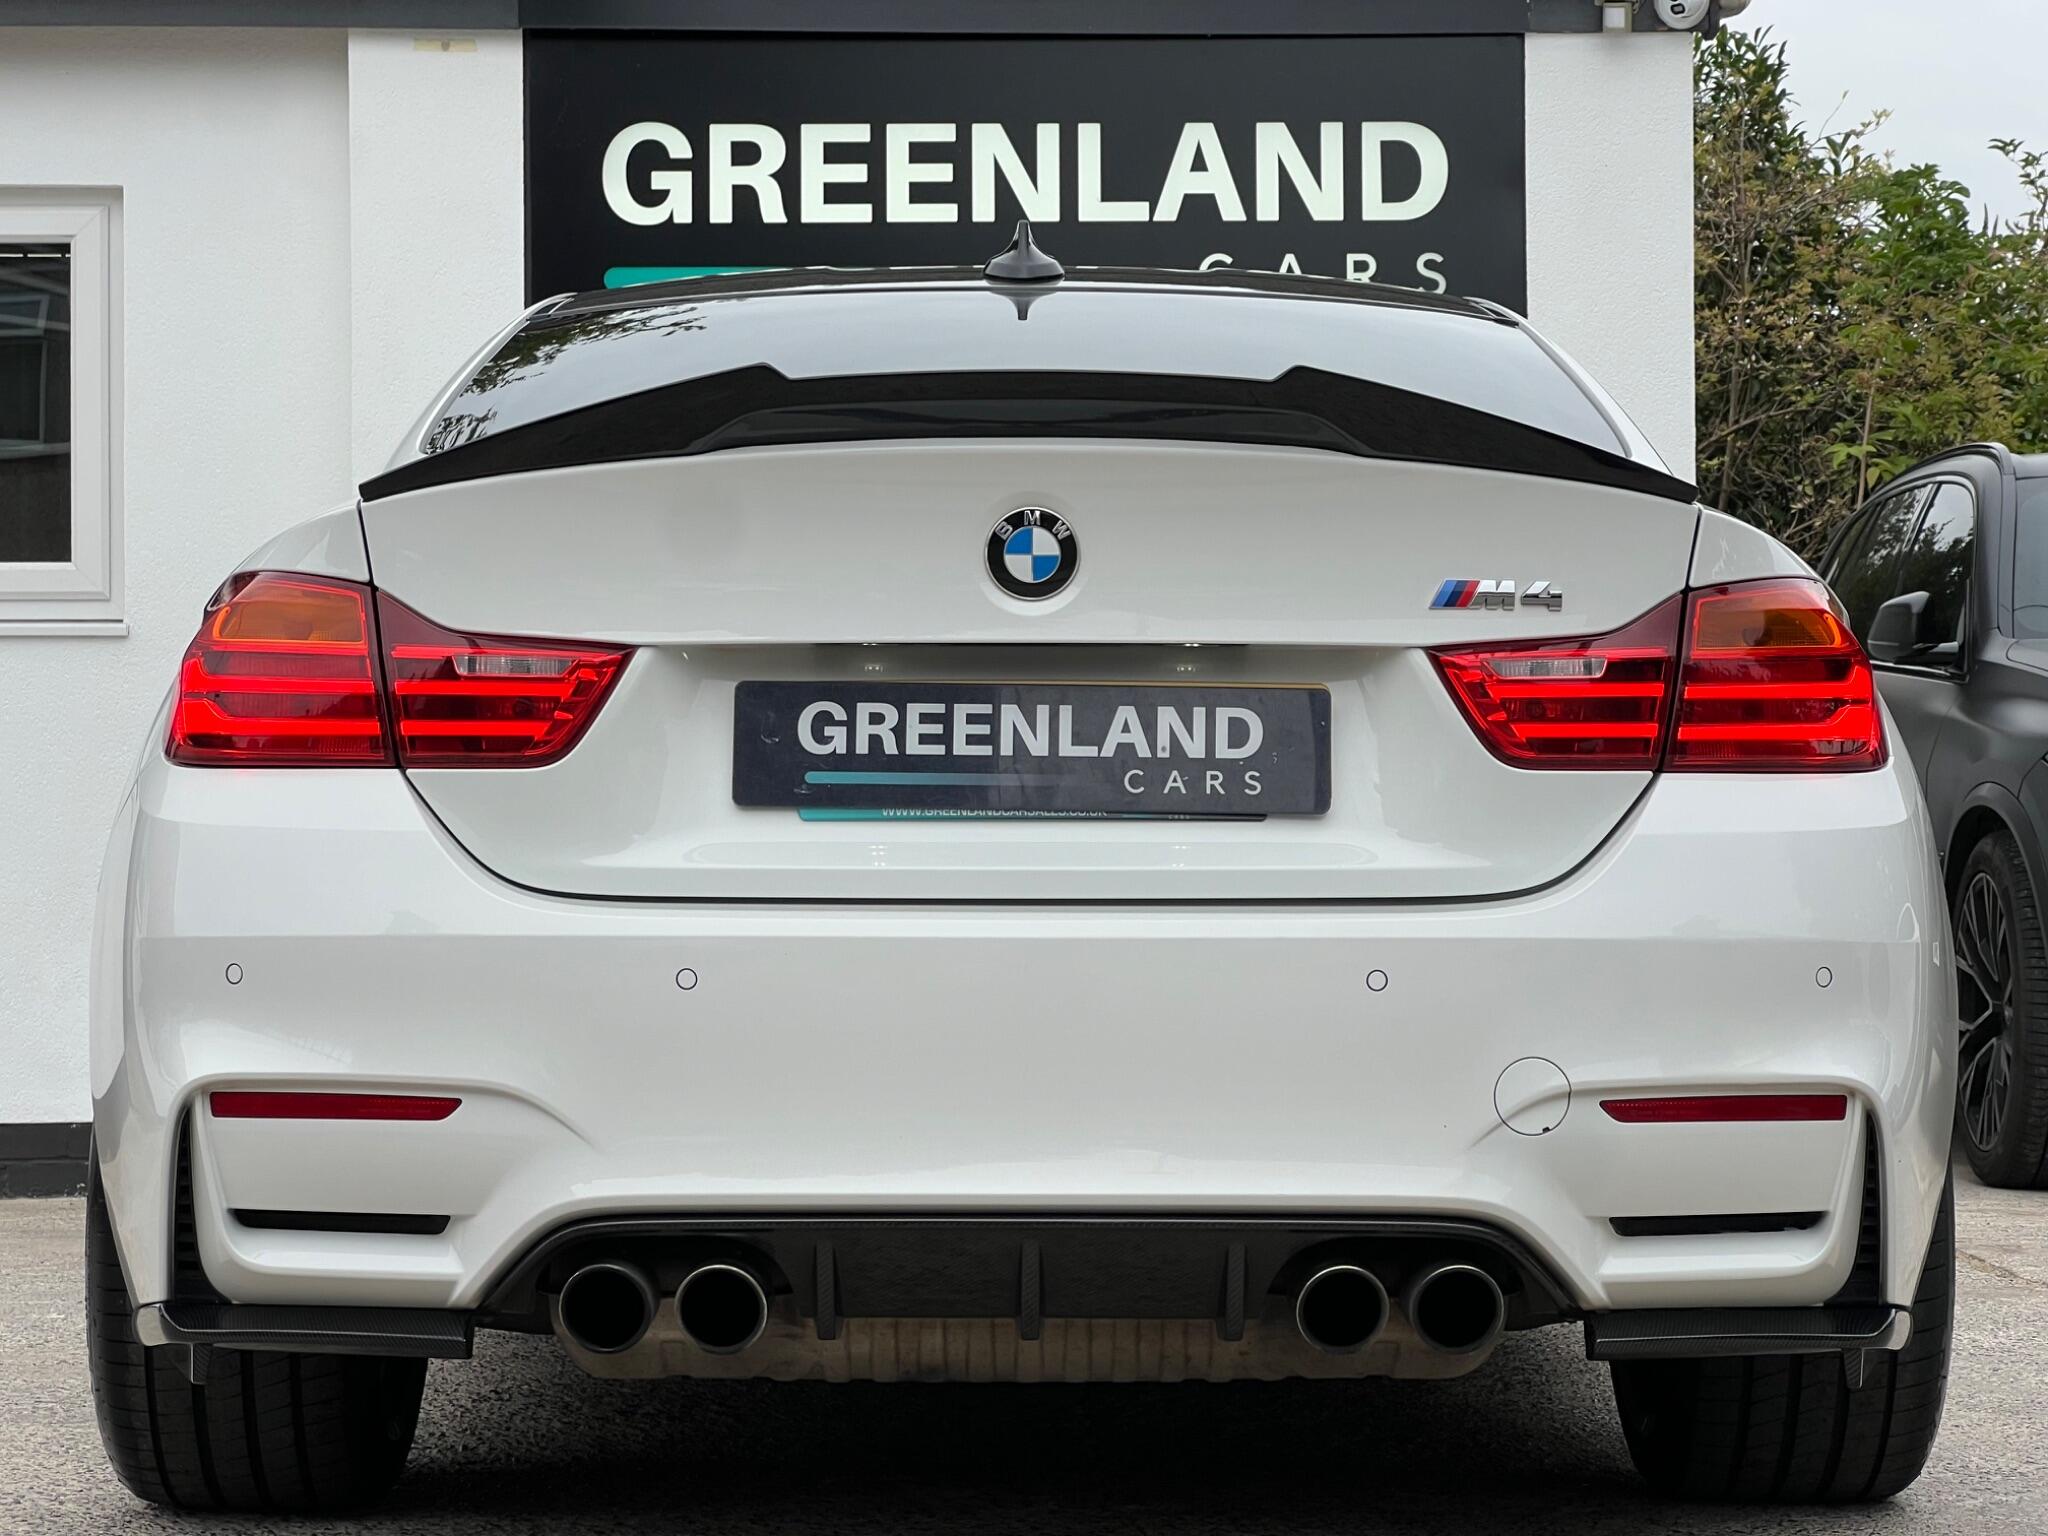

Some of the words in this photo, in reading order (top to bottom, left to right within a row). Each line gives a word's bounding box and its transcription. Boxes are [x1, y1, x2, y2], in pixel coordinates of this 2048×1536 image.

[602, 121, 1450, 226] GREENLAND
[995, 510, 1071, 540] BMW
[1466, 579, 1562, 612] M4
[798, 701, 1265, 759] GREENLAND
[1123, 769, 1262, 795] CARS
